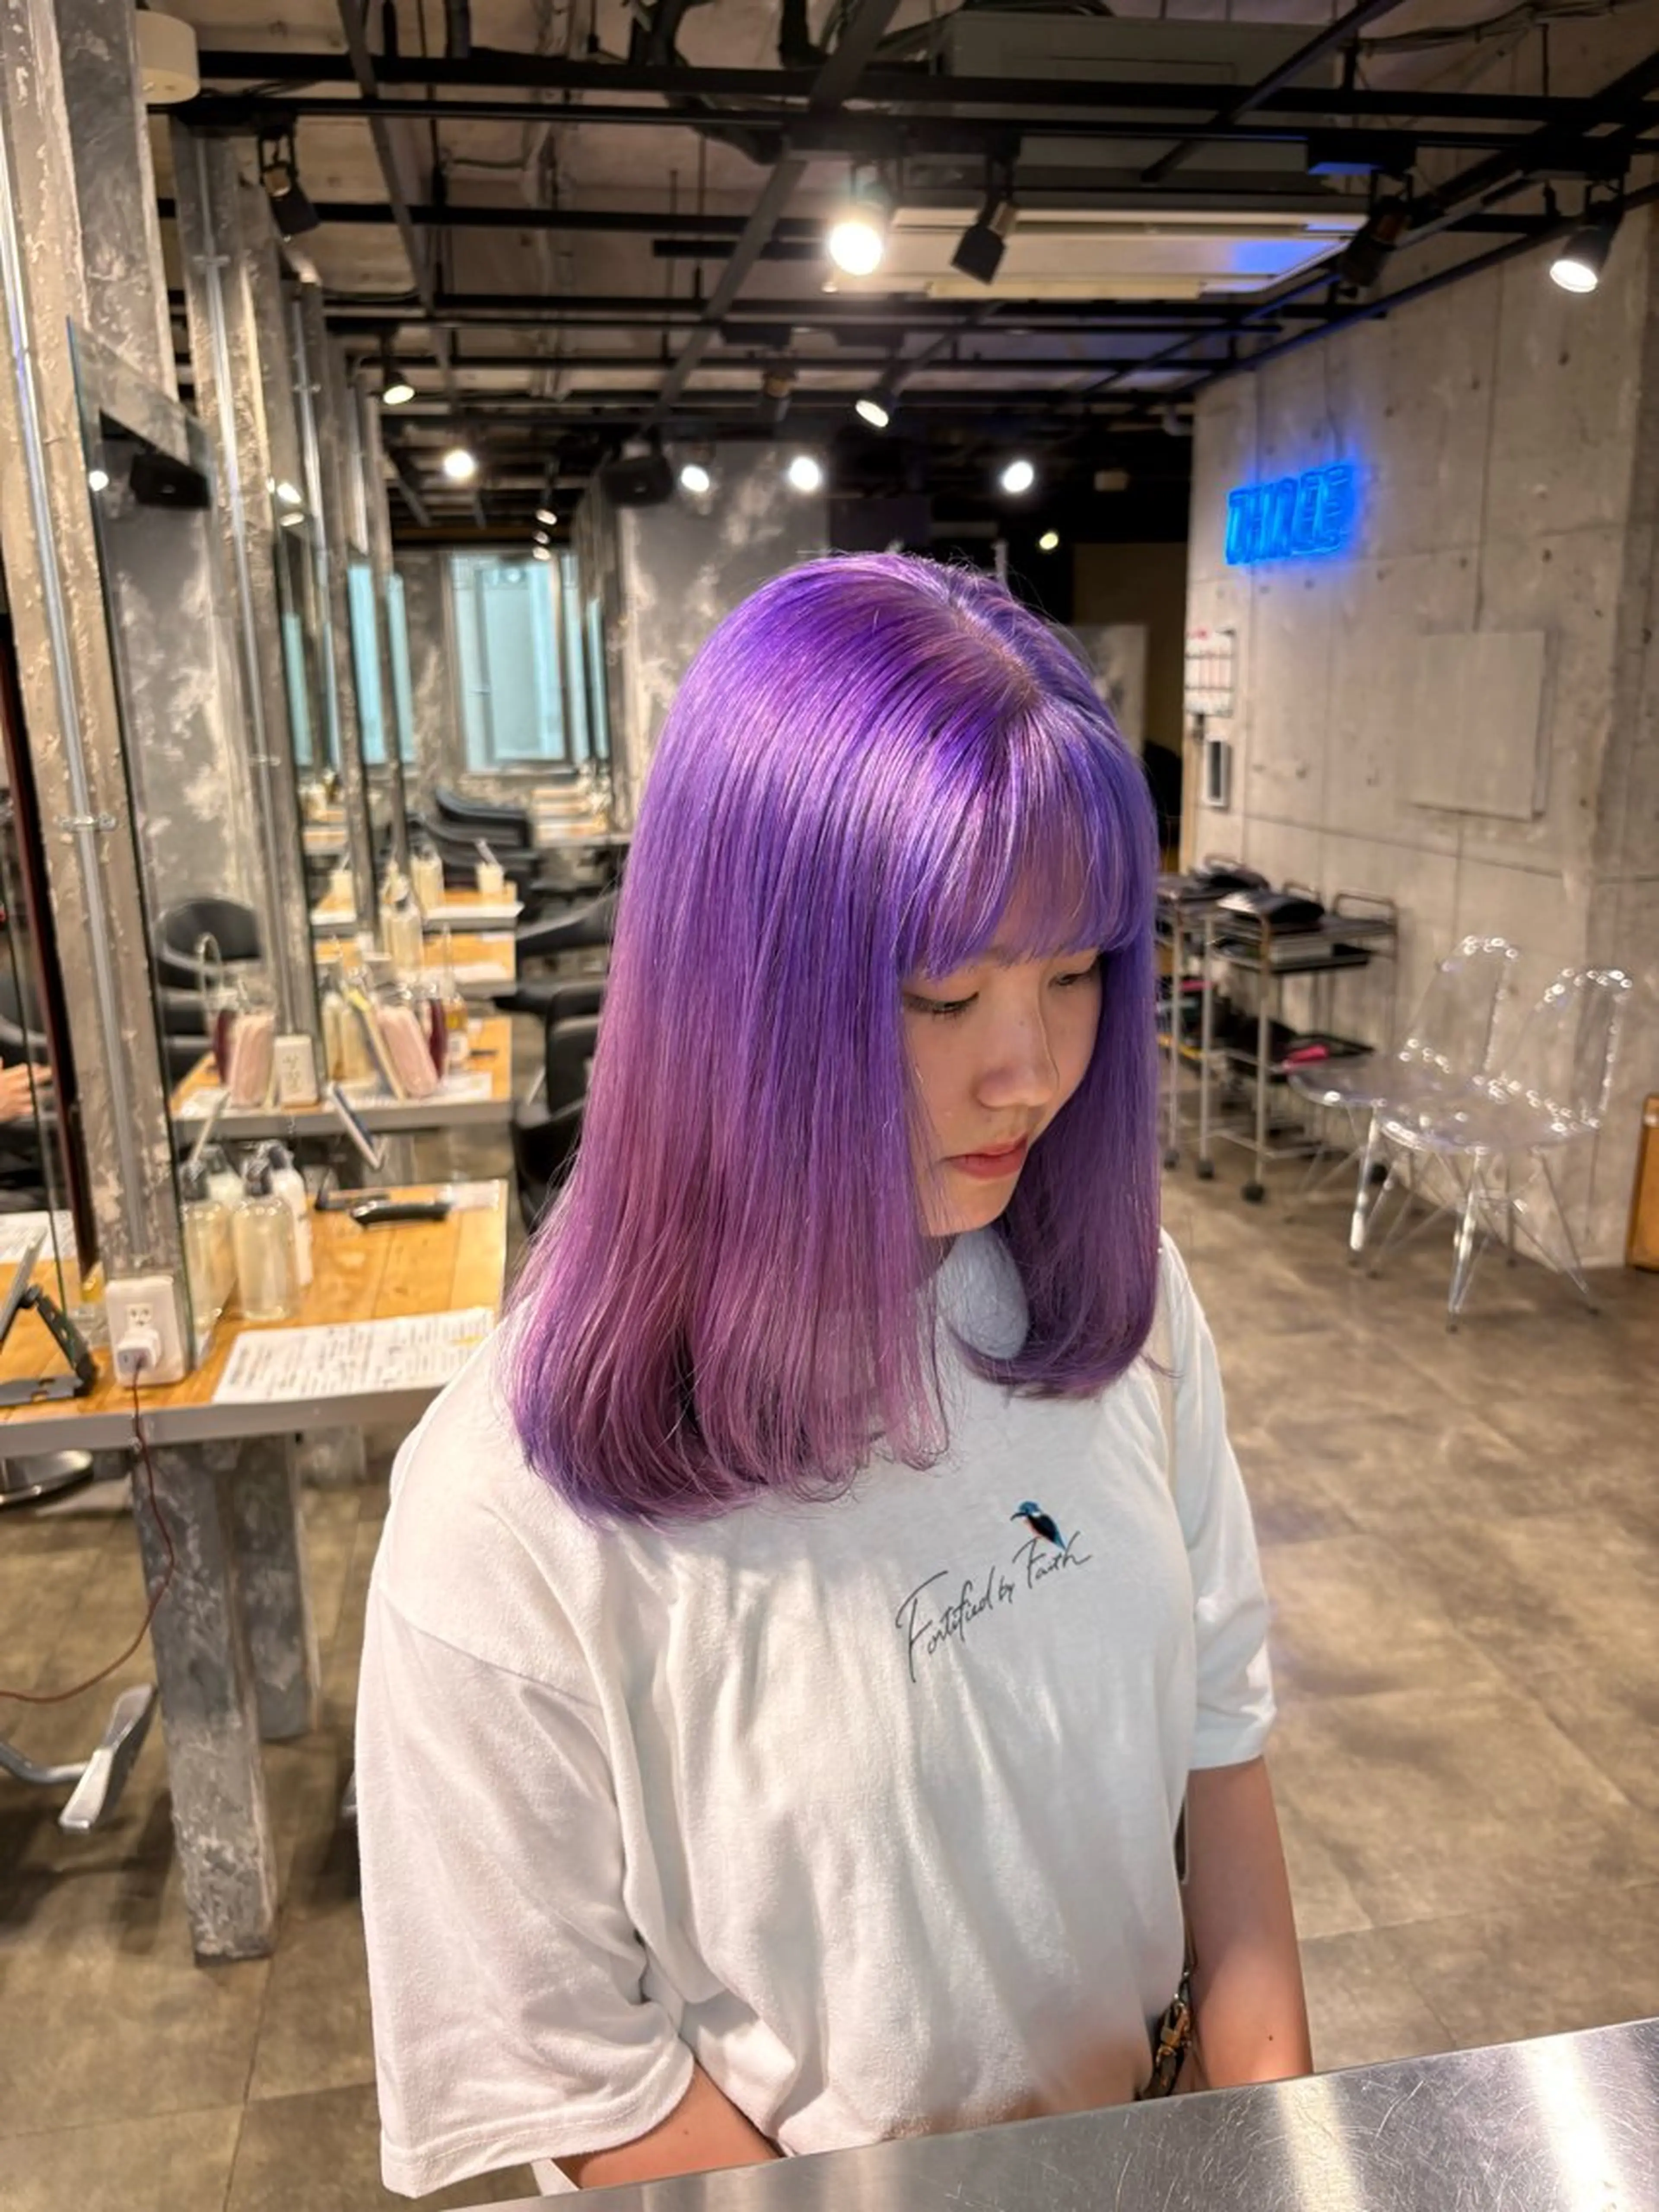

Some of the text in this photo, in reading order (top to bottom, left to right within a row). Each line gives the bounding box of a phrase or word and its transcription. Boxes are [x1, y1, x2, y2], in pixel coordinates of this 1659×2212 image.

[895, 1531, 1093, 1683] Fortified by Faith
